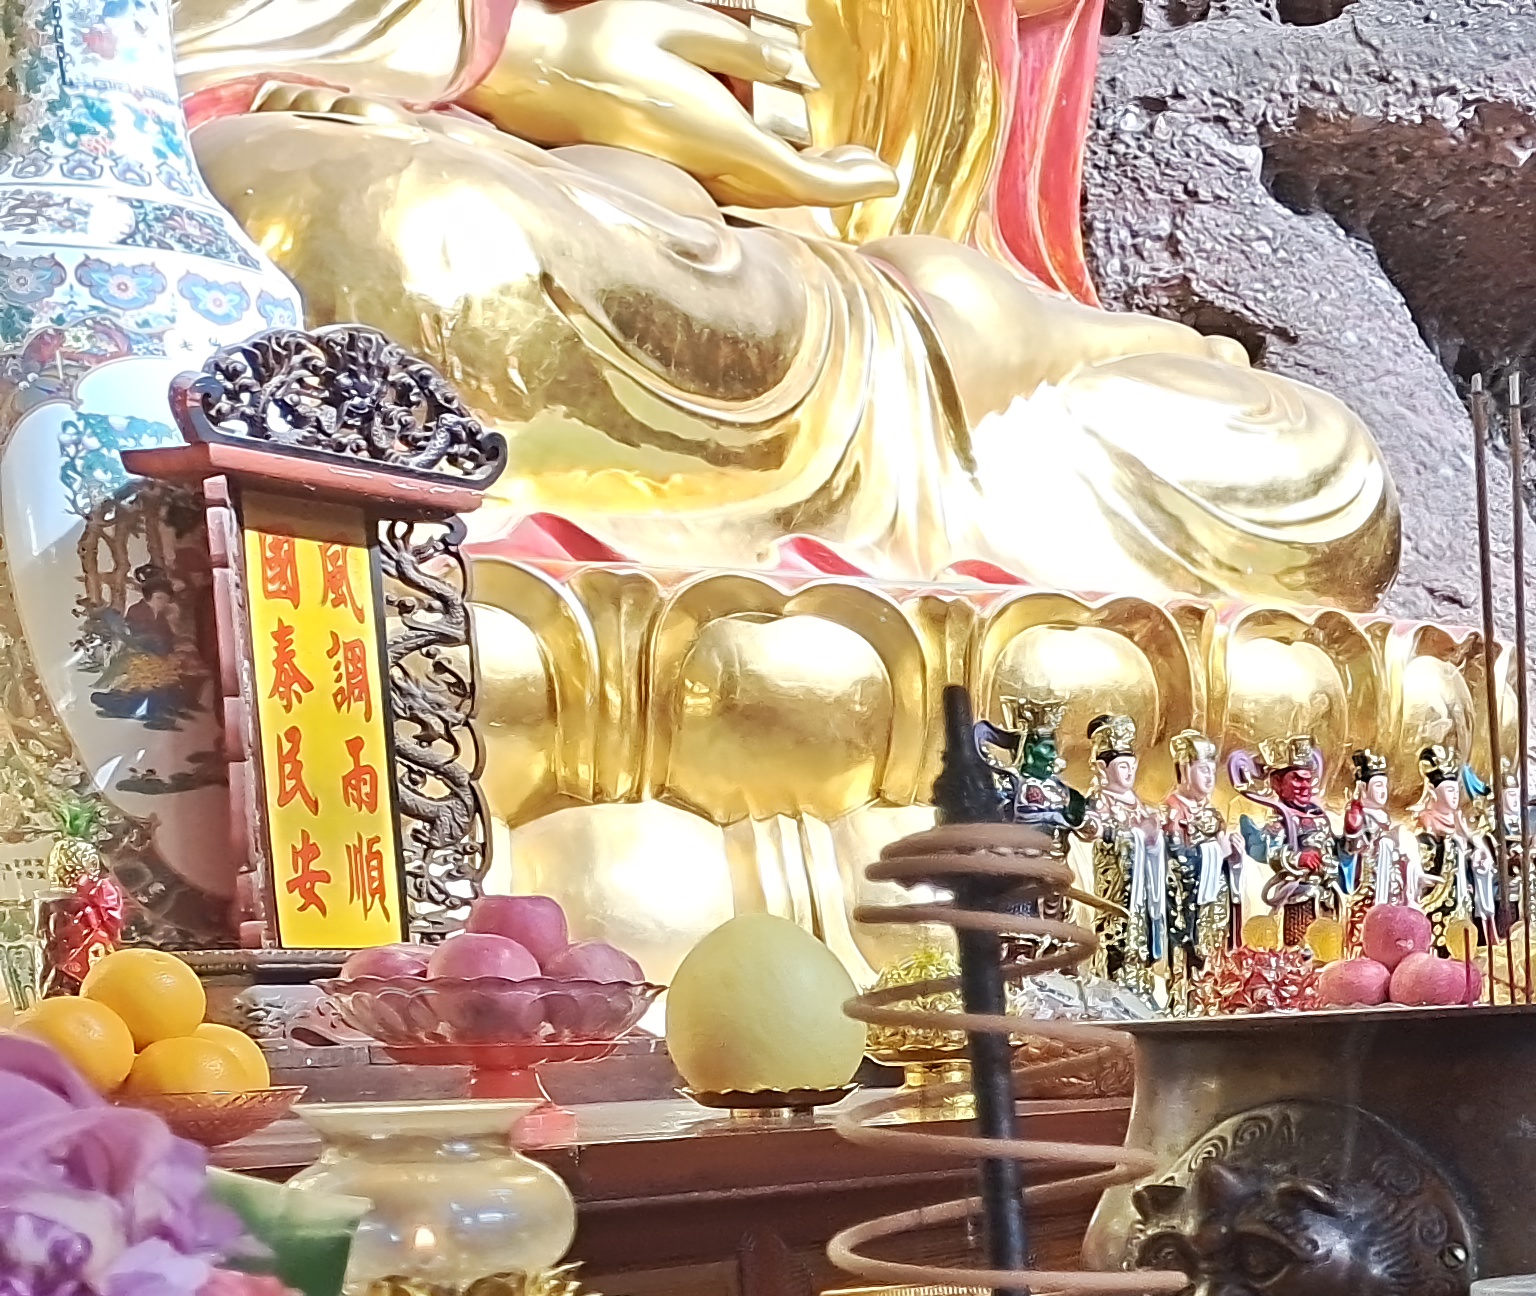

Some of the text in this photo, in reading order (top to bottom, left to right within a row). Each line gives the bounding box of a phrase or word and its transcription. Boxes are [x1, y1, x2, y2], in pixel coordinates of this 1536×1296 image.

[258, 524, 332, 919] 國泰民安
[317, 533, 391, 923] 風調雨順
